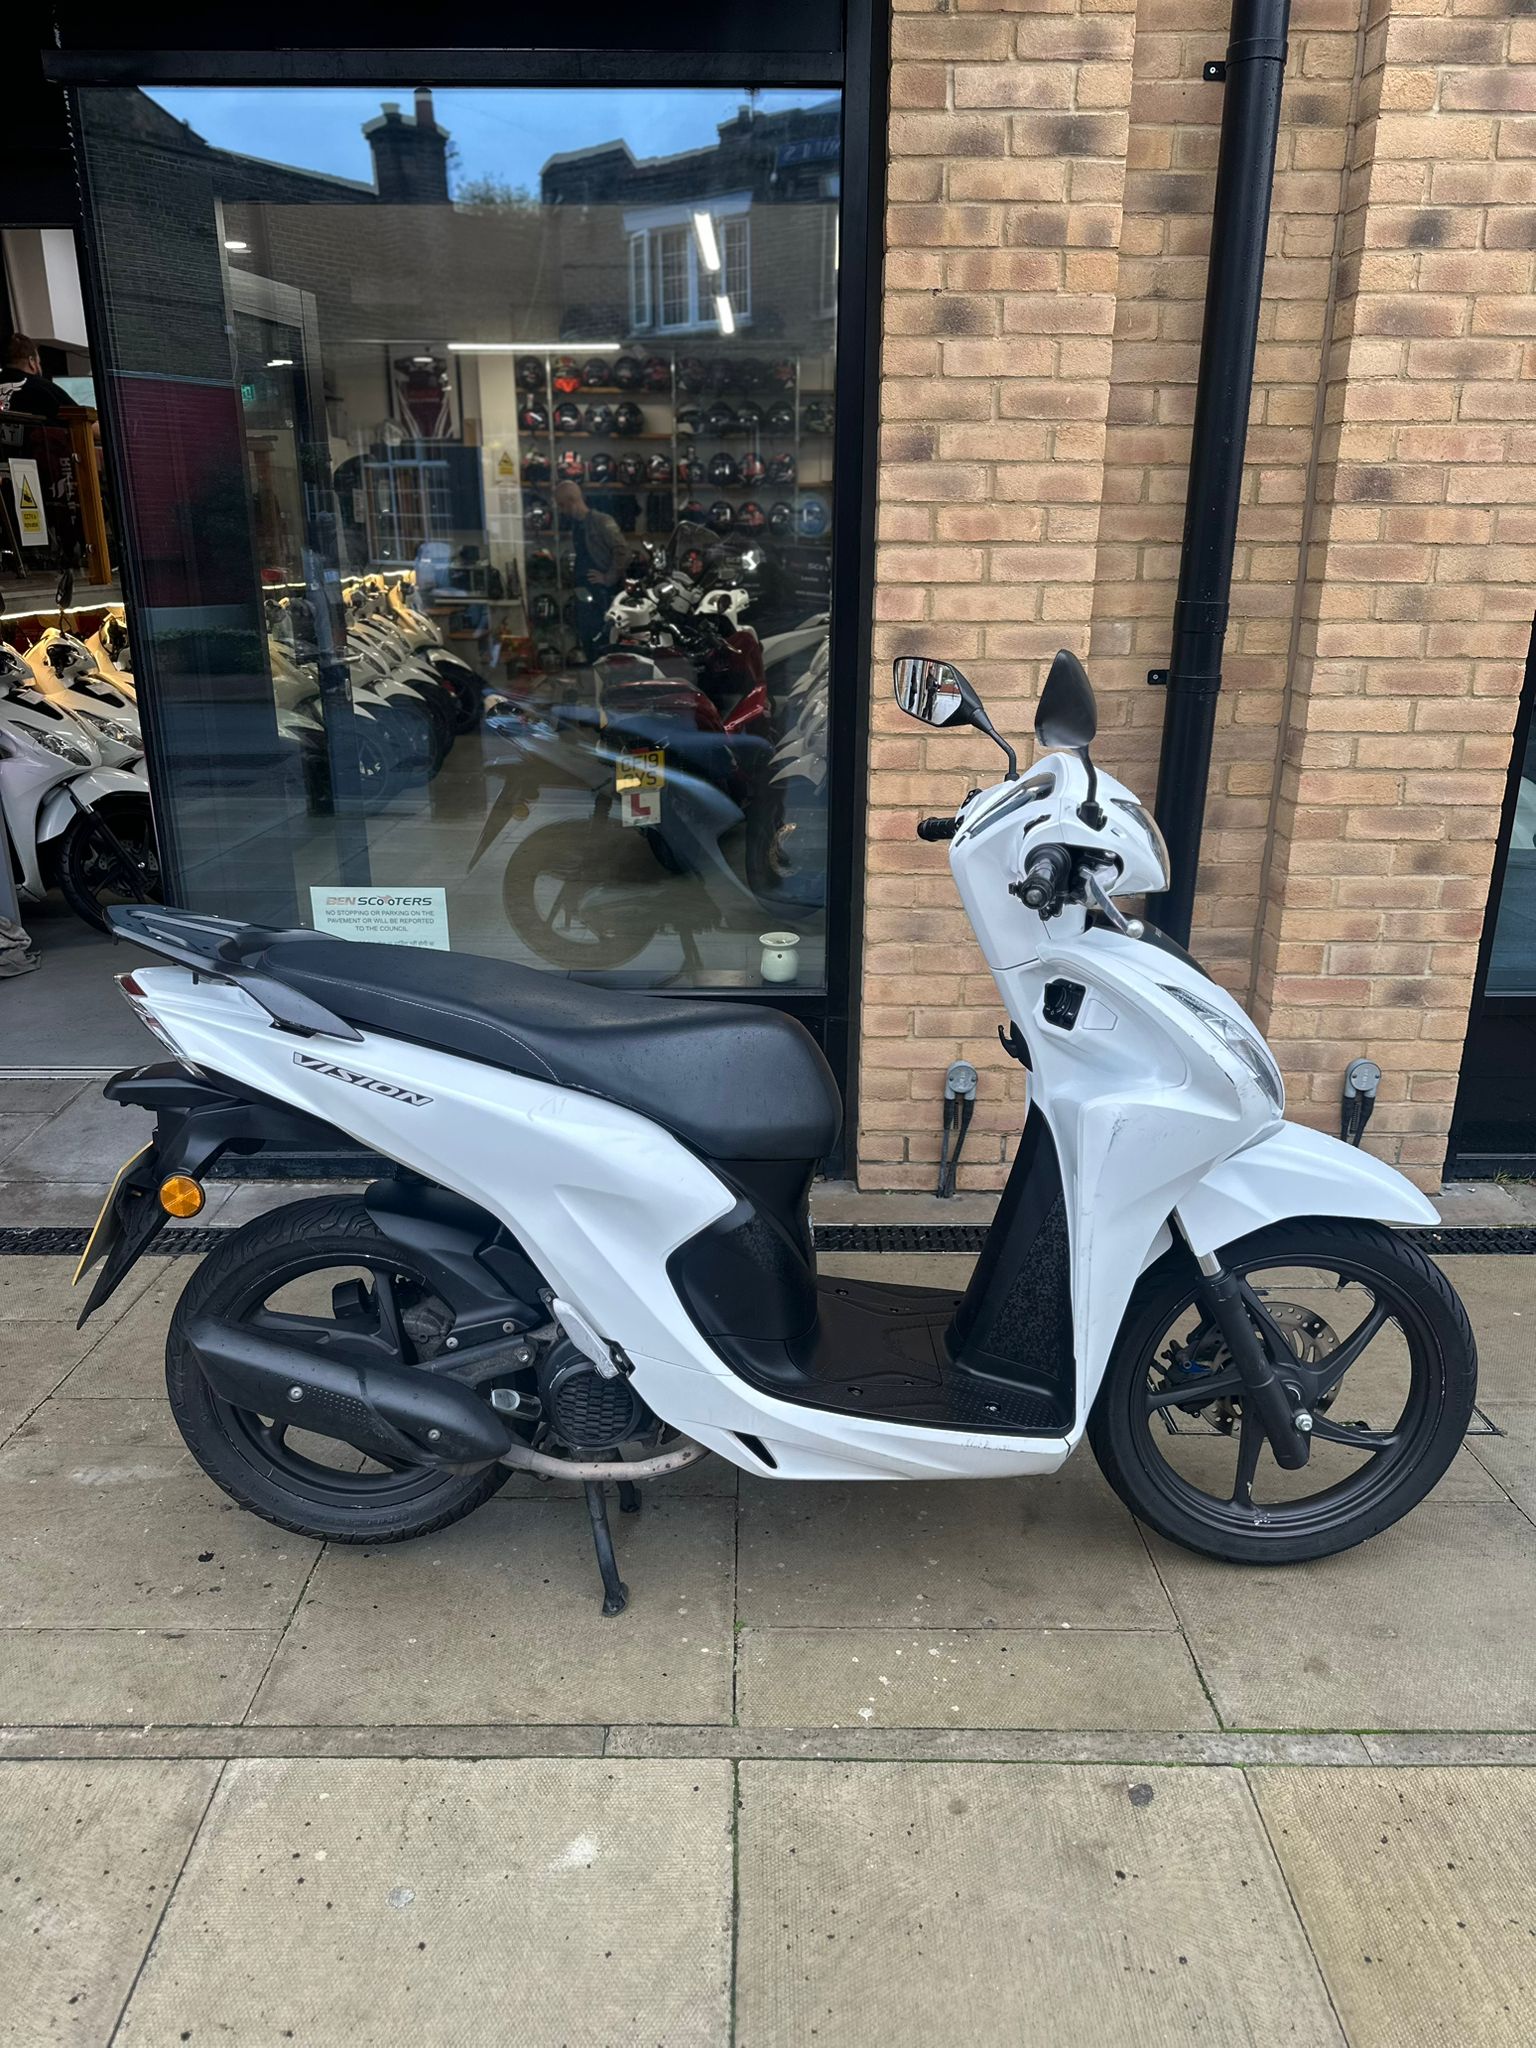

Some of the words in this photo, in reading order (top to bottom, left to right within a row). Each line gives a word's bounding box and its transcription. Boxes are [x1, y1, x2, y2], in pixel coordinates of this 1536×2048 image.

[623, 770, 657, 786] YS
[630, 793, 651, 817] L
[326, 896, 356, 906] BEN
[357, 896, 432, 906] SCOOTERS
[293, 1052, 433, 1106] VISION
